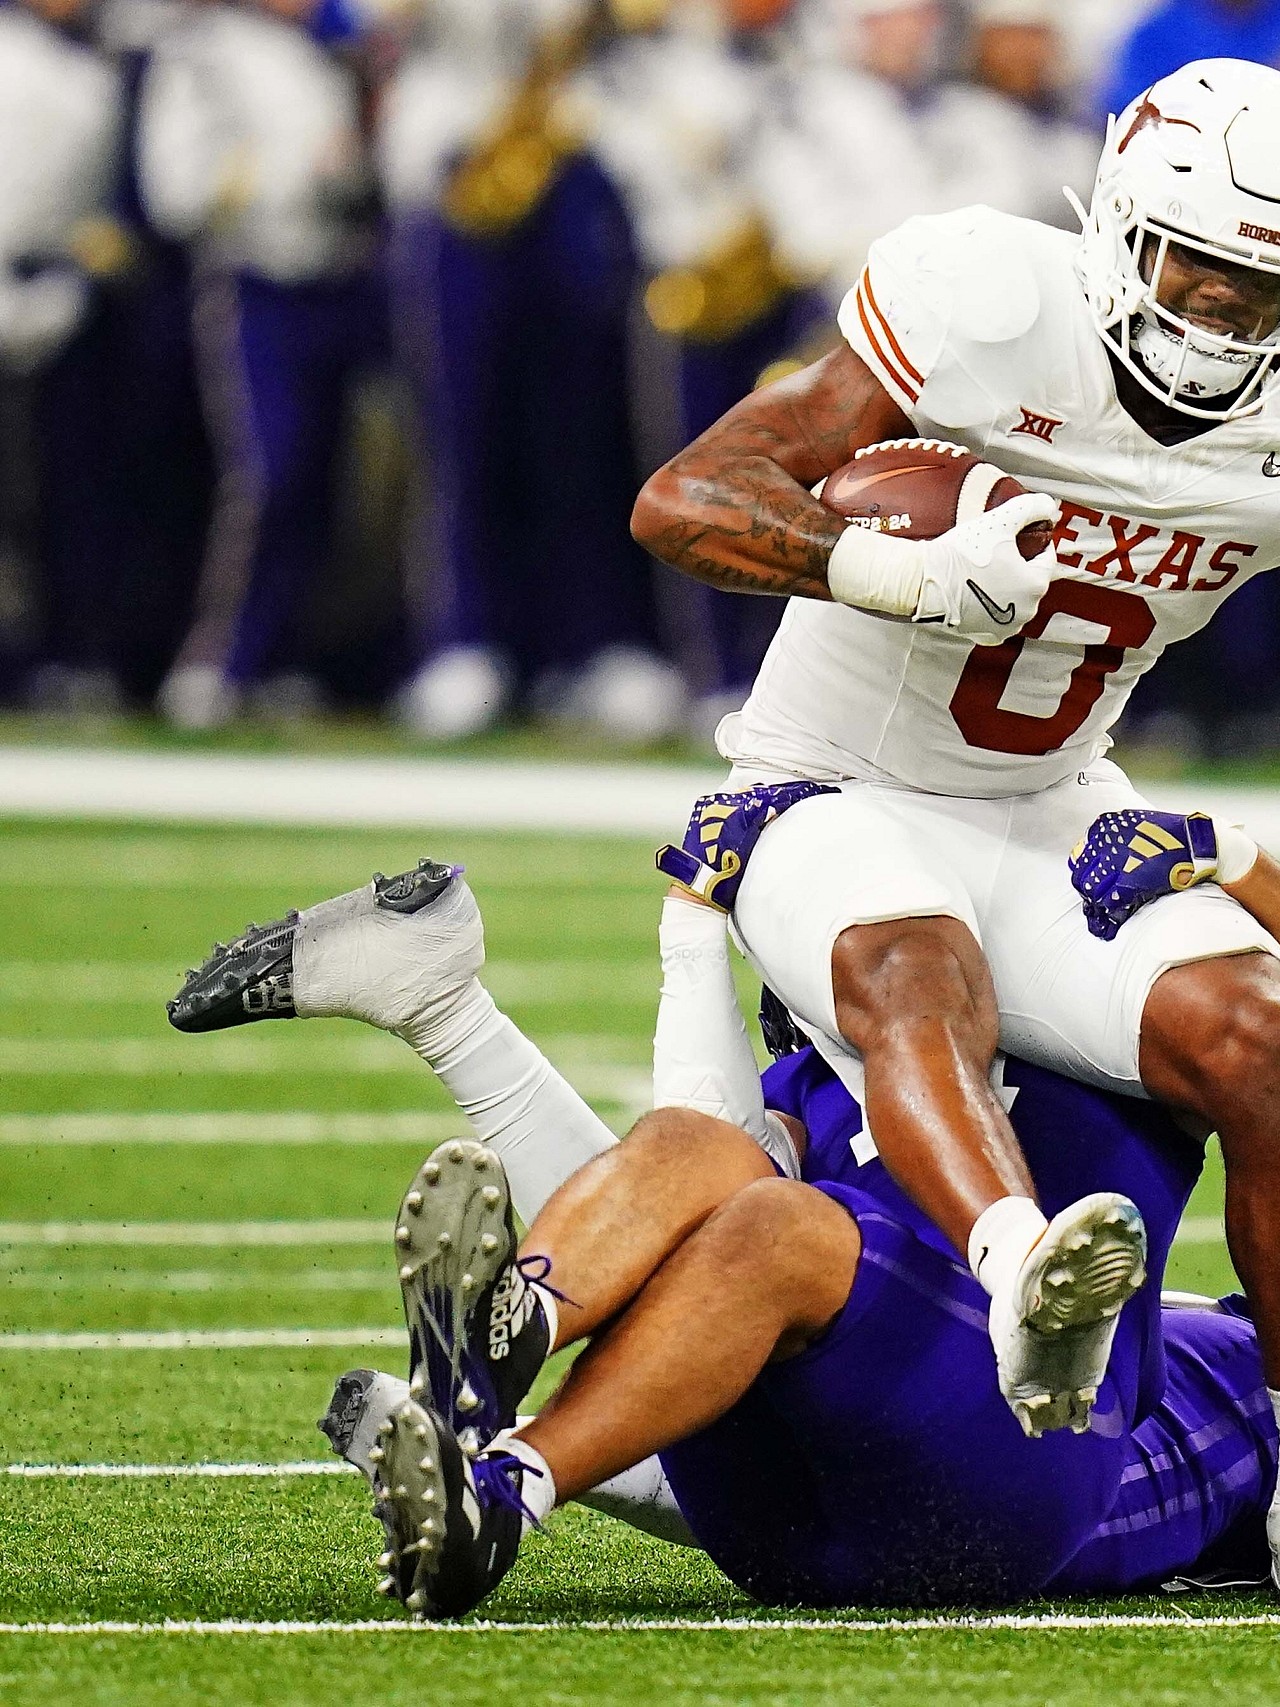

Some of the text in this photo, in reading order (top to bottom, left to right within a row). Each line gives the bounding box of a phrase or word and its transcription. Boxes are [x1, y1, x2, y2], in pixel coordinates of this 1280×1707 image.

[1010, 406, 1063, 444] XII
[1052, 500, 1258, 591] EXAS
[949, 577, 1156, 756] 0
